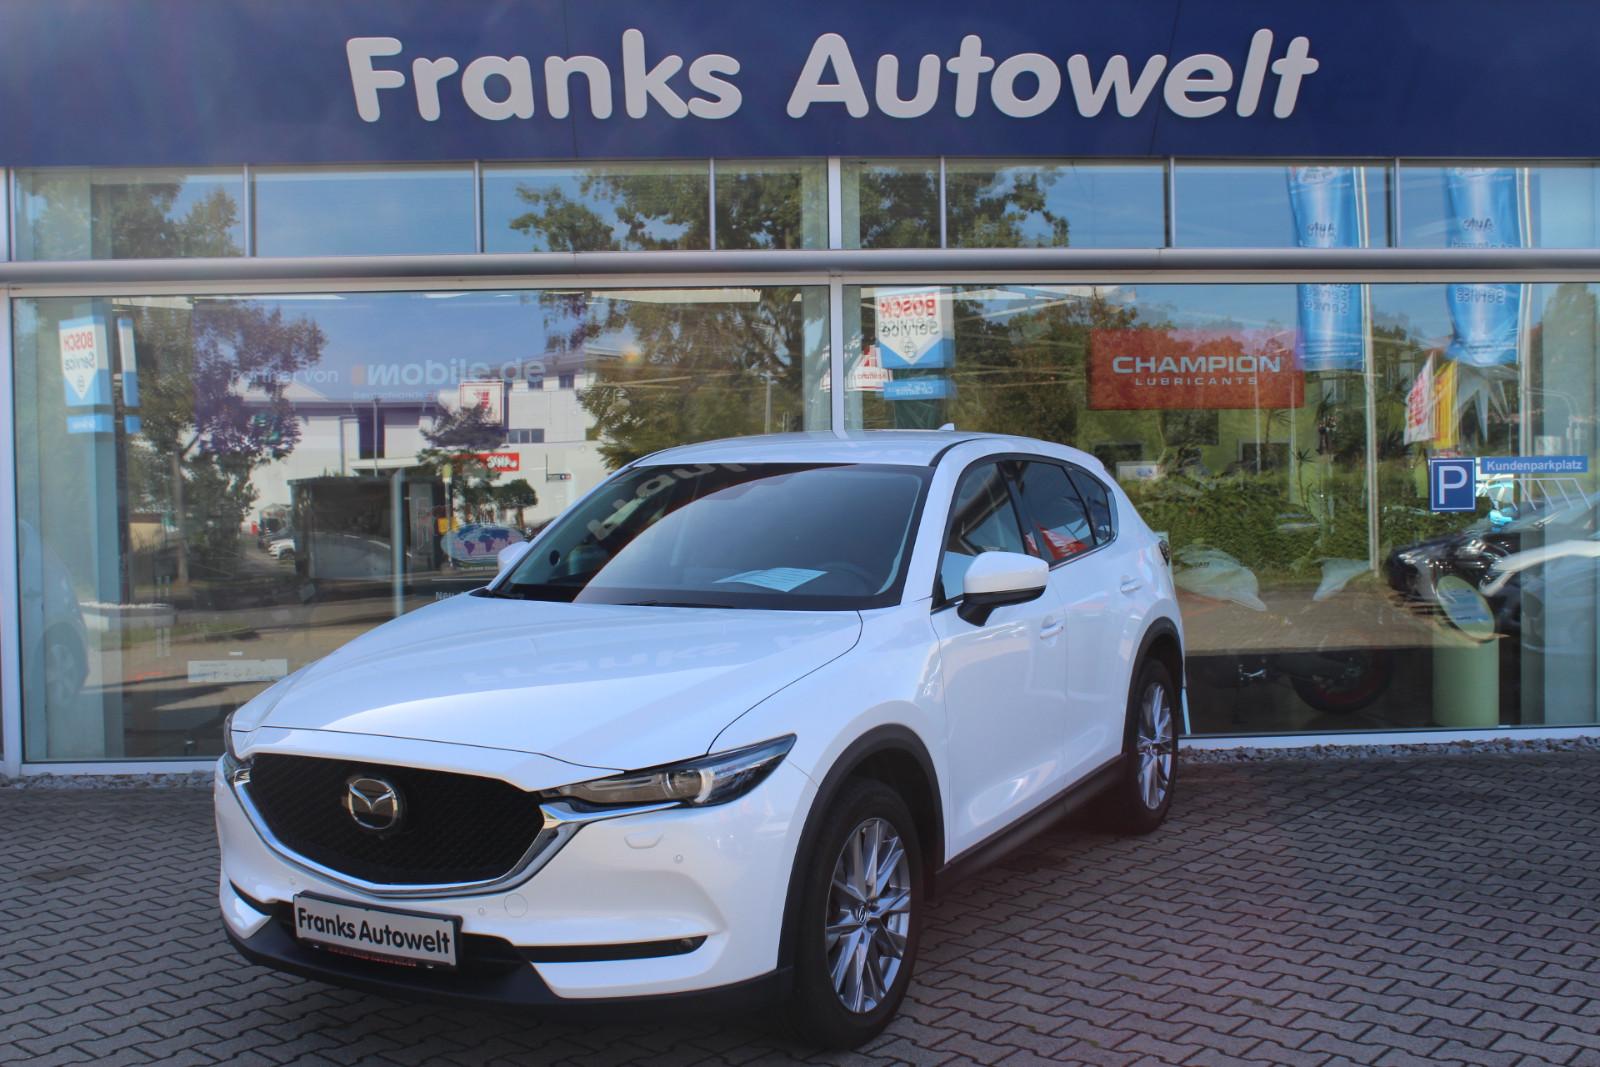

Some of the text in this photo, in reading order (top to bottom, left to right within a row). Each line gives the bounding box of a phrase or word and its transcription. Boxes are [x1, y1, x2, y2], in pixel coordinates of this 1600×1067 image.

[346, 28, 1320, 123] Franks Autowelt
[1113, 356, 1280, 373] CHAMPION
[303, 372, 339, 384] von
[1135, 376, 1258, 386] LUBRICANTS
[1487, 460, 1583, 473] Kundenparkplatz
[1438, 465, 1468, 505] P
[297, 907, 450, 954] Franks Autowelt
